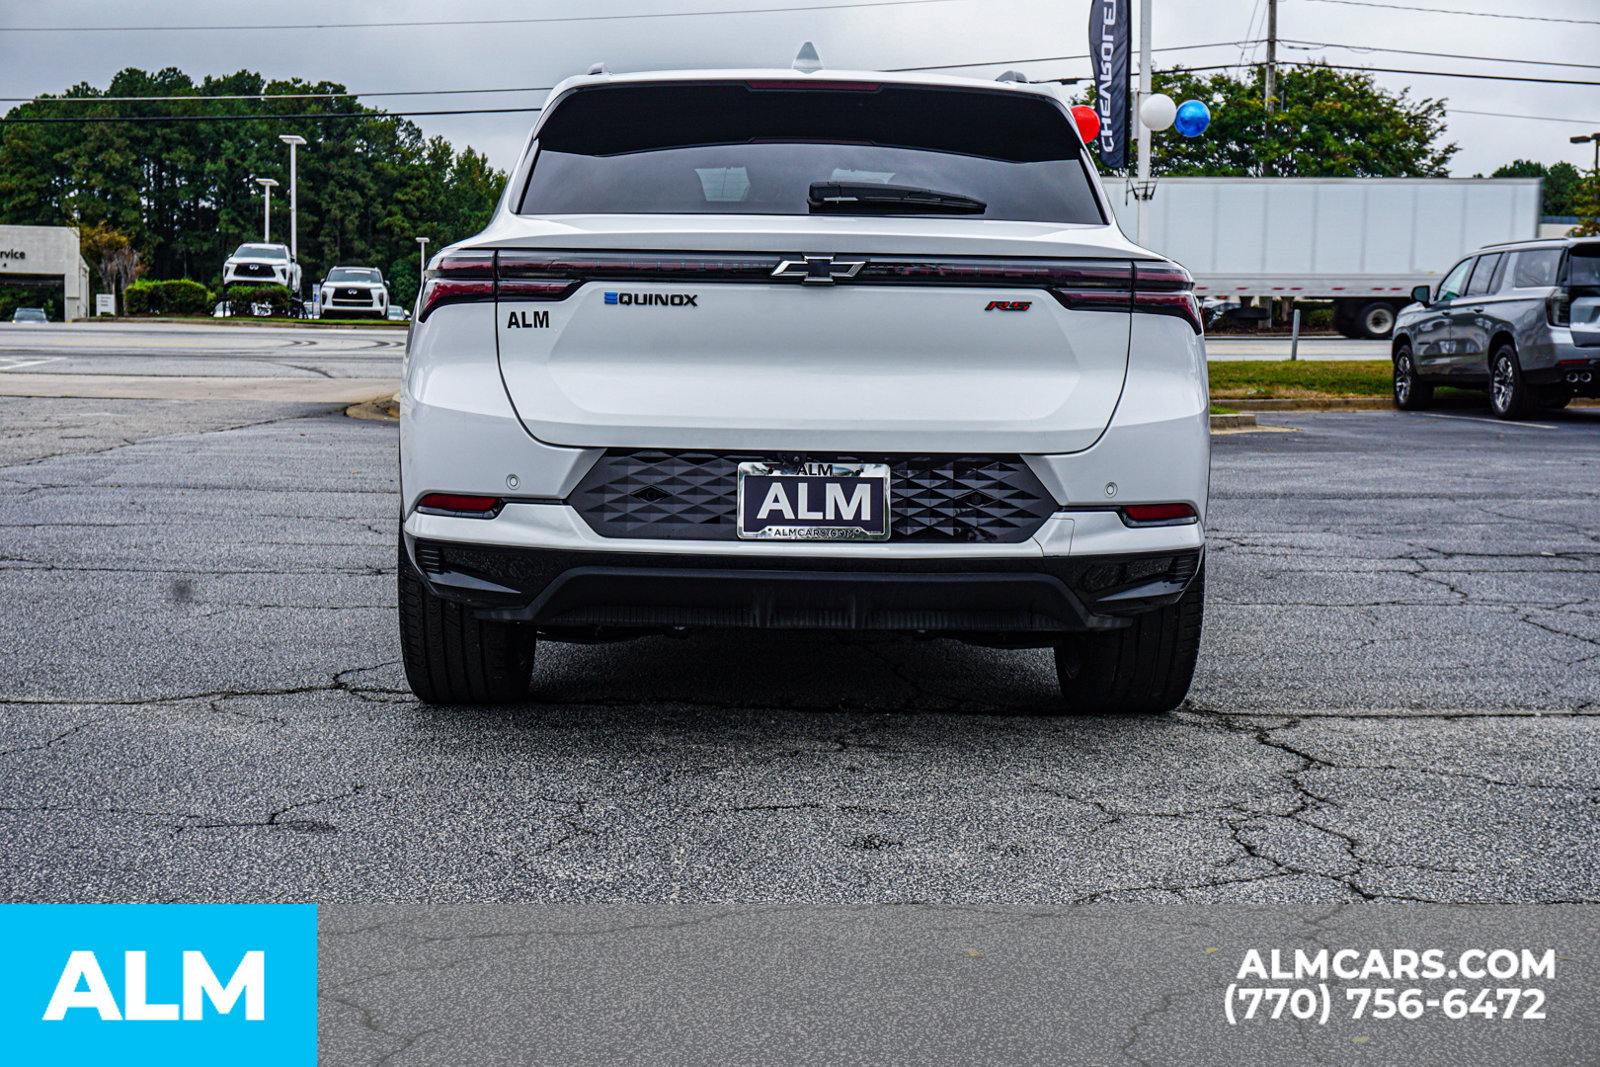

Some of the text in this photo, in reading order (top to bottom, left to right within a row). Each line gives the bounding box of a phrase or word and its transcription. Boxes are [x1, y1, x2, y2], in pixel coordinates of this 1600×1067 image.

[604, 292, 698, 306] EQUINOX
[984, 301, 1032, 311] RS
[507, 311, 550, 328] ALM
[797, 463, 833, 475] ALM
[756, 482, 871, 520] ALM
[774, 528, 855, 538] ALMCARS.COM
